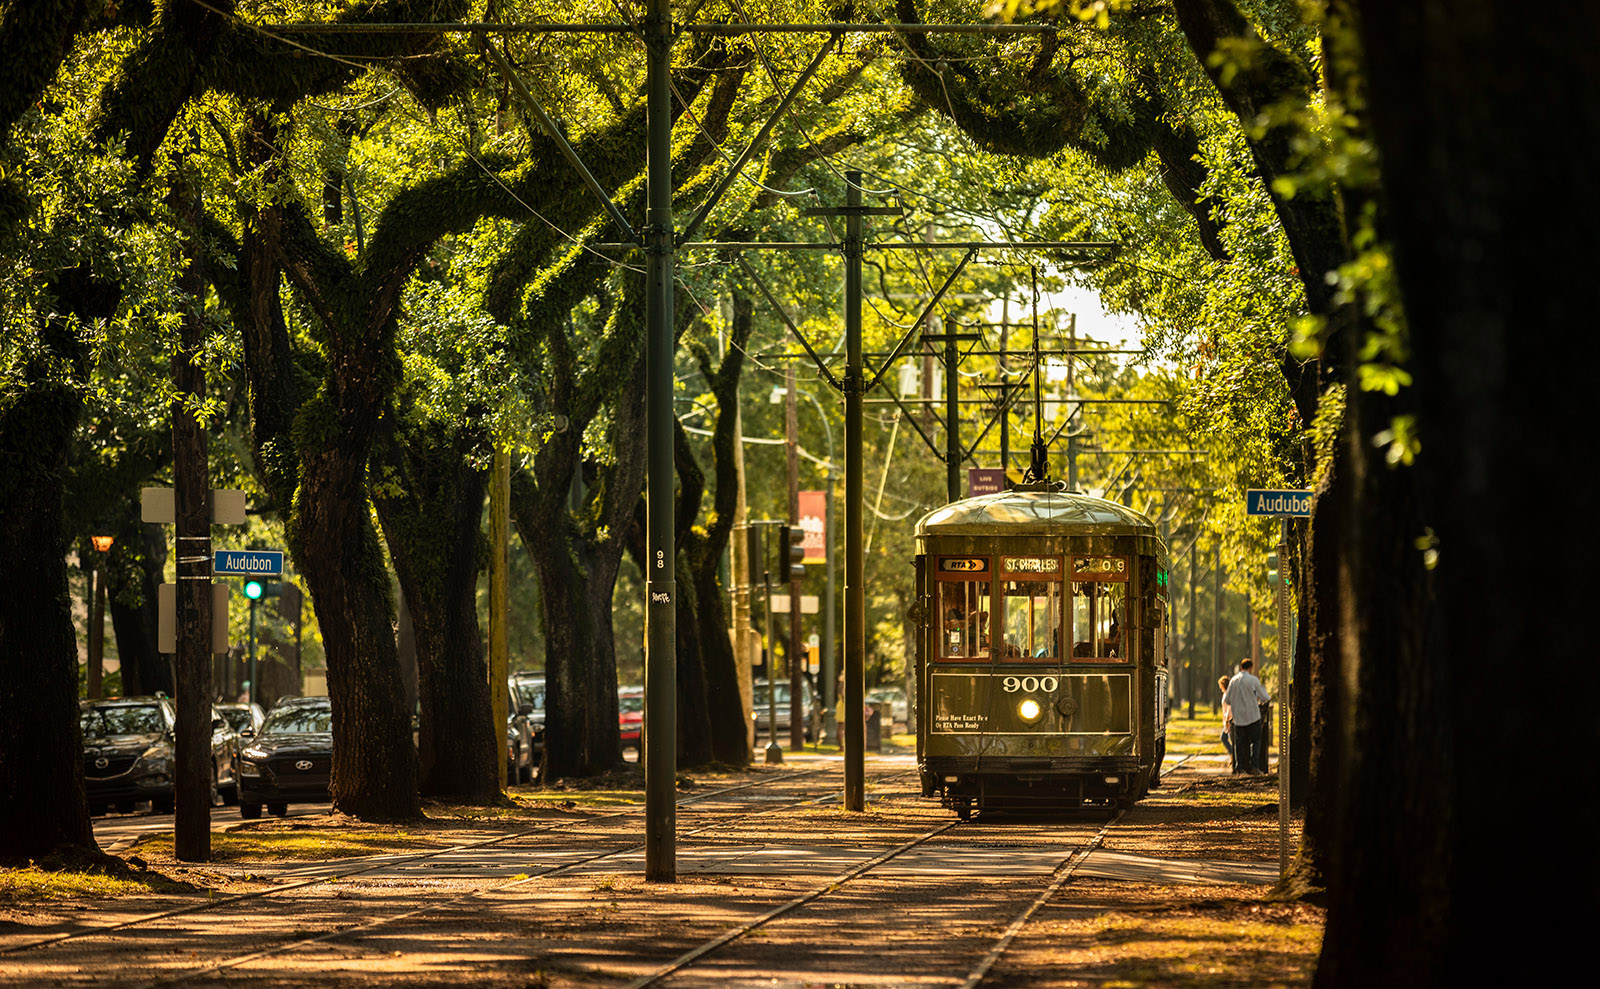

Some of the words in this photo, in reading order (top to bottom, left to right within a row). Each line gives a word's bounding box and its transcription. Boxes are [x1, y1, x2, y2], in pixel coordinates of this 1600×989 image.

[1256, 494, 1310, 513] Audubo
[225, 554, 272, 571] Audubon
[951, 561, 967, 569] RTA
[1006, 559, 1018, 570] ST.
[1019, 559, 1057, 571] CHARLES
[1003, 676, 1058, 693] 900
[964, 722, 979, 730] Ready
